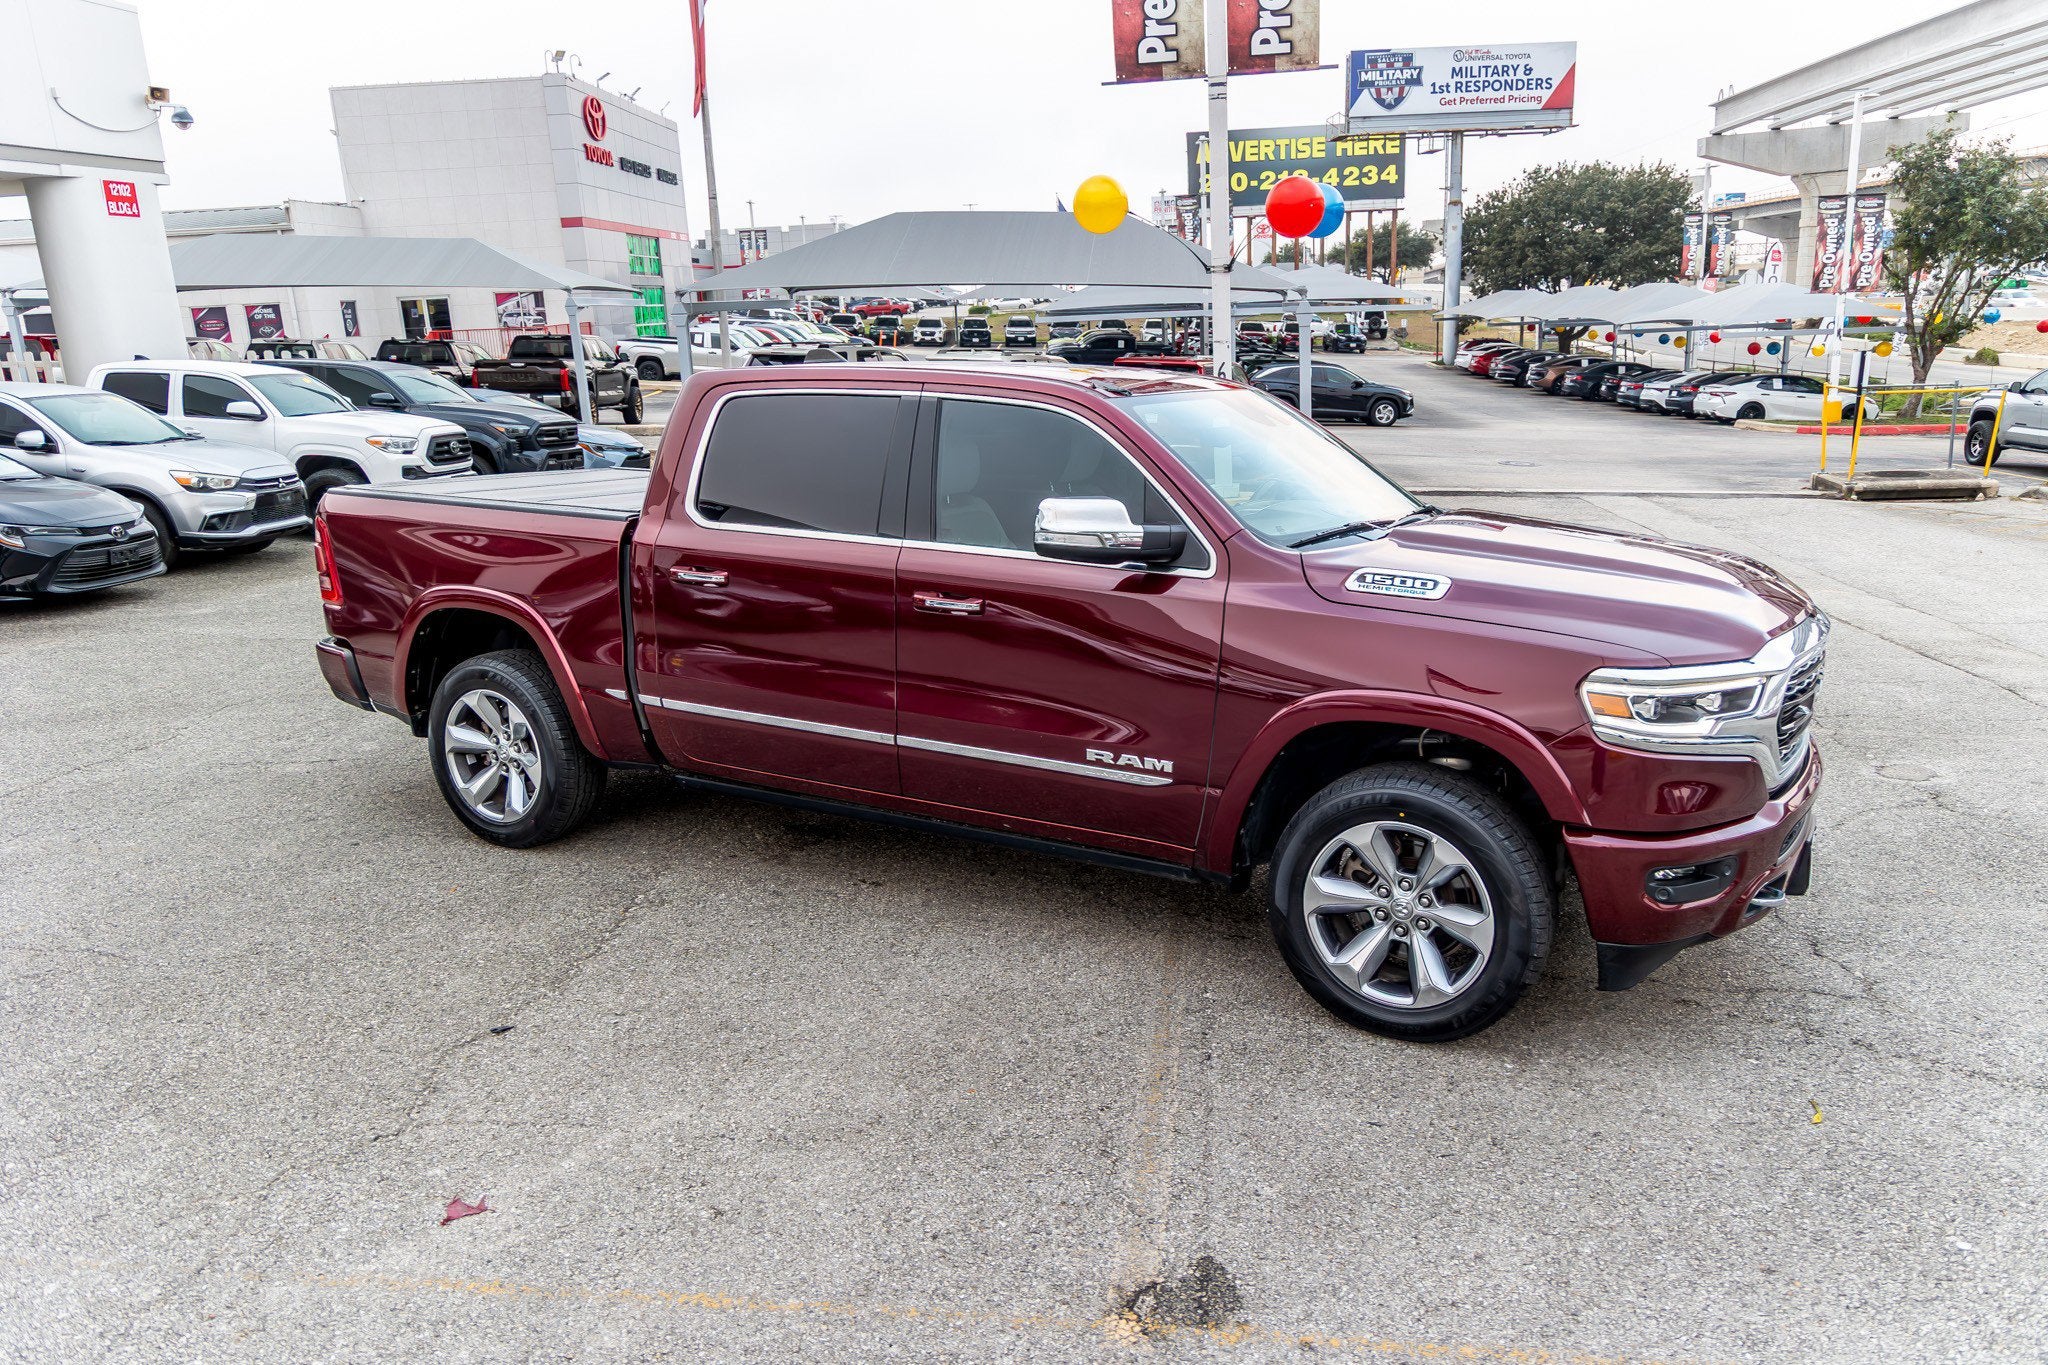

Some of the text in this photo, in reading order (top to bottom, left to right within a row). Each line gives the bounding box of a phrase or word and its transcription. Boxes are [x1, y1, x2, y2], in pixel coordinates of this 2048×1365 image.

[1465, 54, 1503, 62] UNIVERSAL
[1361, 69, 1420, 82] MILITARY
[1451, 64, 1534, 79] MILITARY &
[1430, 77, 1553, 94] 1st RESPONDERS
[1439, 94, 1543, 106] Get Preferred Pricing
[585, 143, 614, 167] TOYOTA
[1196, 134, 1400, 164] AVERTISE HERE
[1199, 165, 1399, 193] 0-2-4234
[108, 183, 132, 197] 12102
[1822, 218, 1839, 264] Owned
[1859, 216, 1876, 263] Owned
[1362, 573, 1435, 590] 1500
[1086, 748, 1174, 773] RAM
